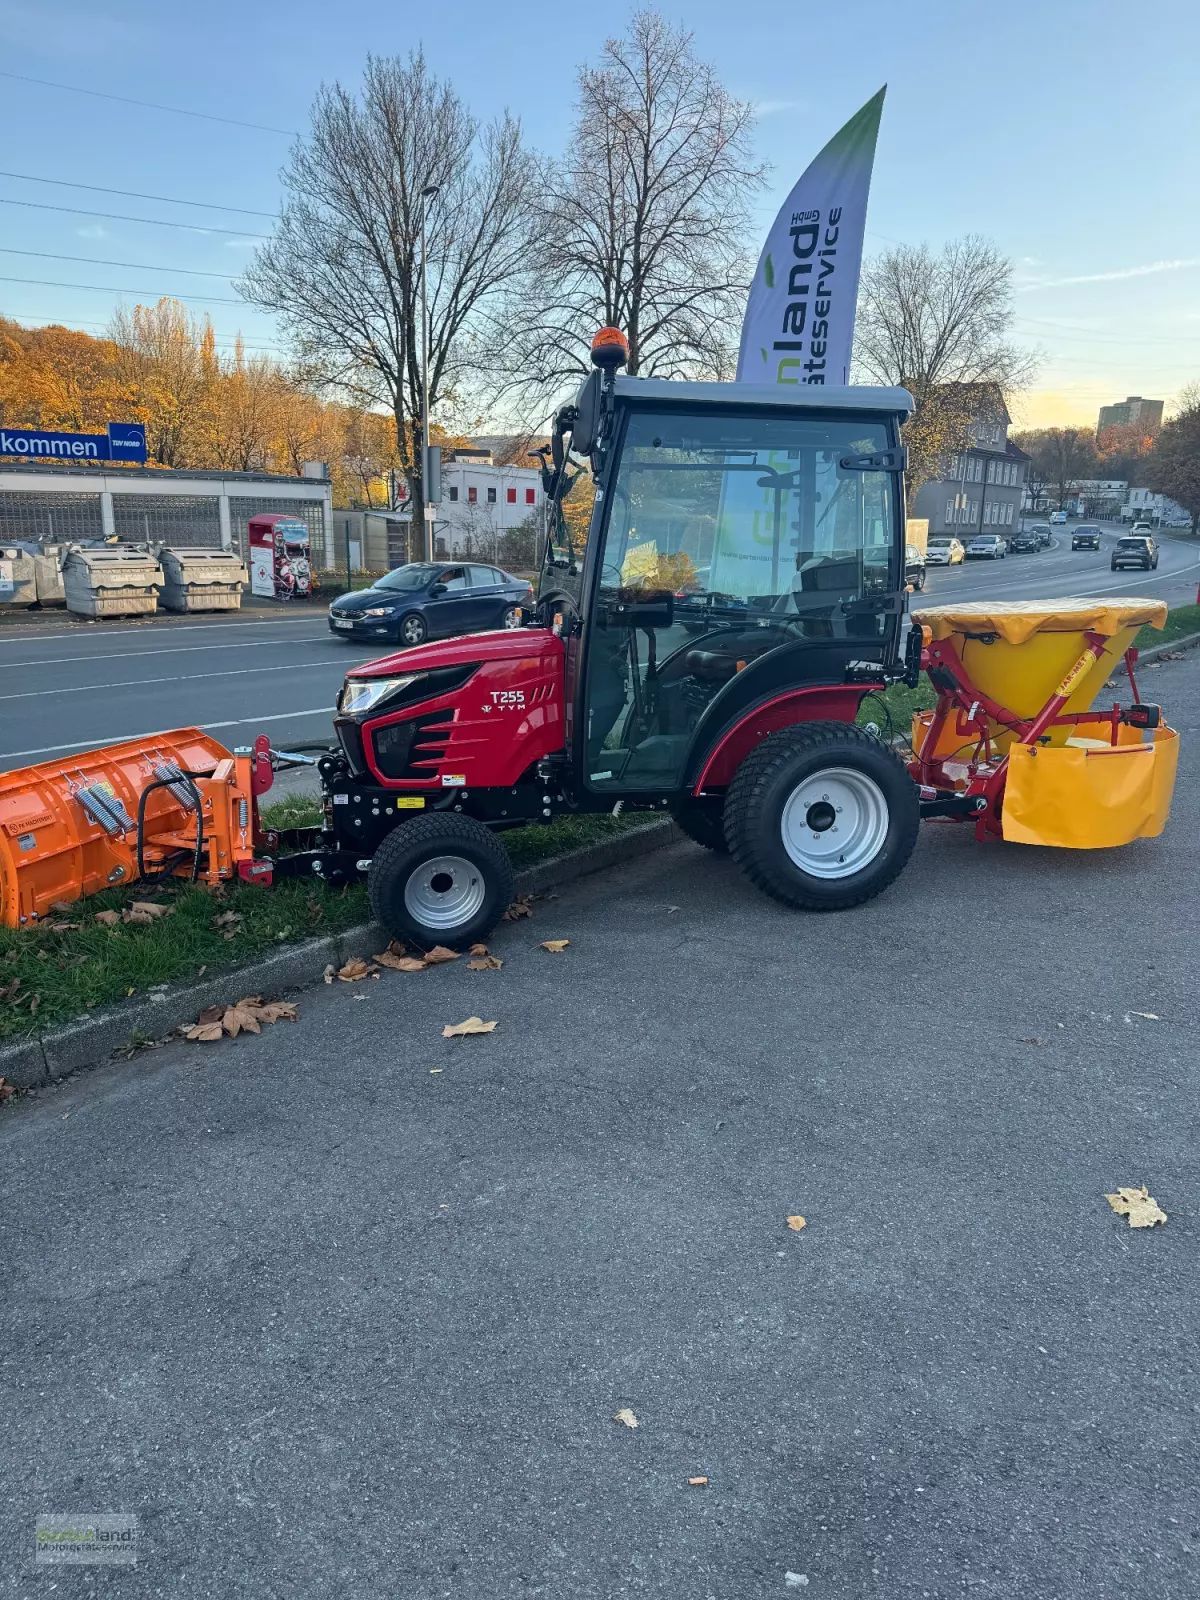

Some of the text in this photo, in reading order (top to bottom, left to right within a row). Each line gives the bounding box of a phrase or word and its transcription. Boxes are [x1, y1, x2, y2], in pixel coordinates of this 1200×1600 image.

[791, 209, 820, 225] GmbH
[0, 433, 98, 457] kommen
[123, 440, 140, 448] NORD
[490, 691, 525, 704] T255
